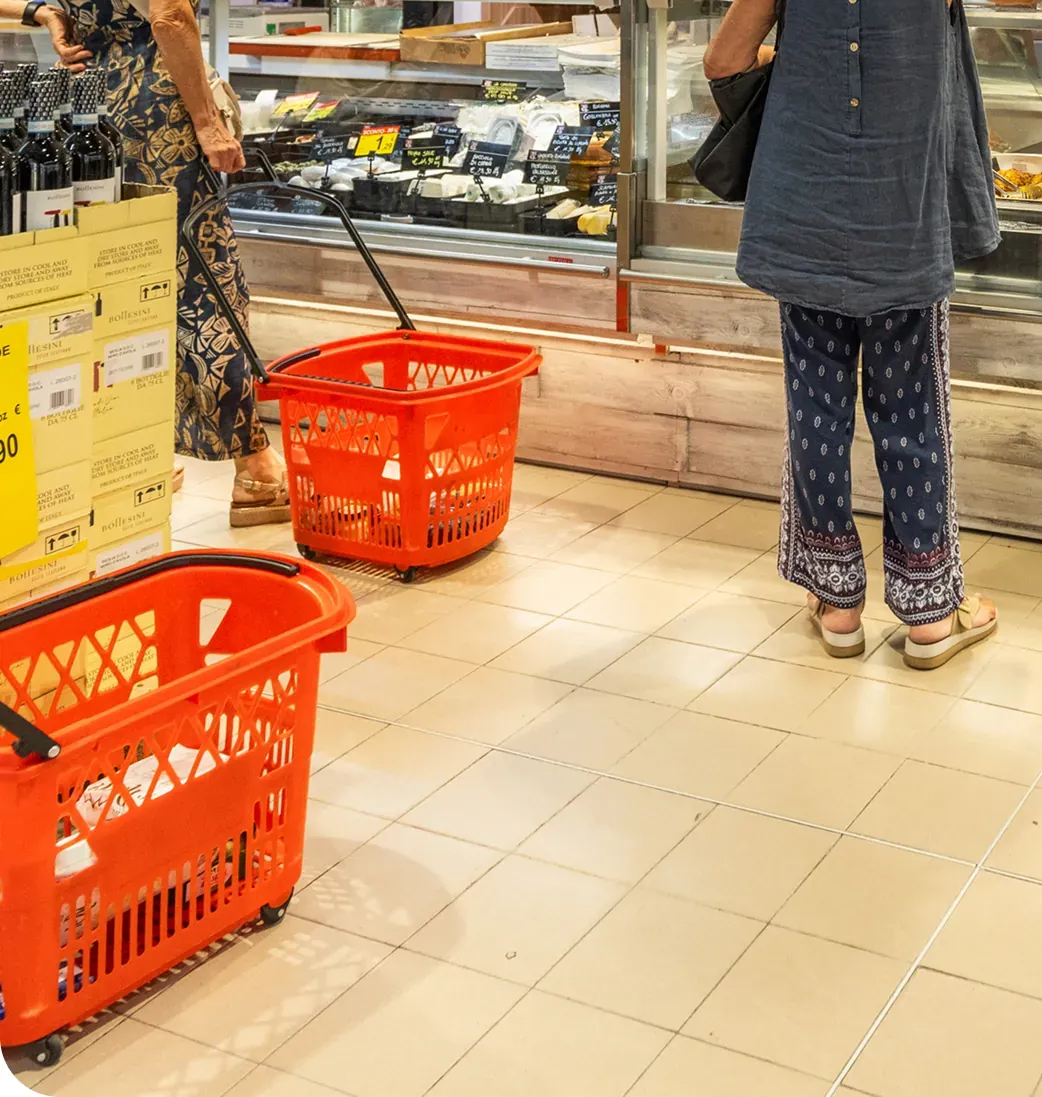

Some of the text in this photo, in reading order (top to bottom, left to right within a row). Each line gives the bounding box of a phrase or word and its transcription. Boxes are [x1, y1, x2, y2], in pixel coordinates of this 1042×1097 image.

[22, 265, 31, 273] IN
[32, 263, 52, 271] COOL
[53, 259, 68, 267] AND
[14, 272, 34, 281] STORE
[35, 269, 51, 277] AND
[15, 276, 45, 287] SOURCES
[7, 292, 34, 301] PRODUCT
[14, 403, 21, 415] €
